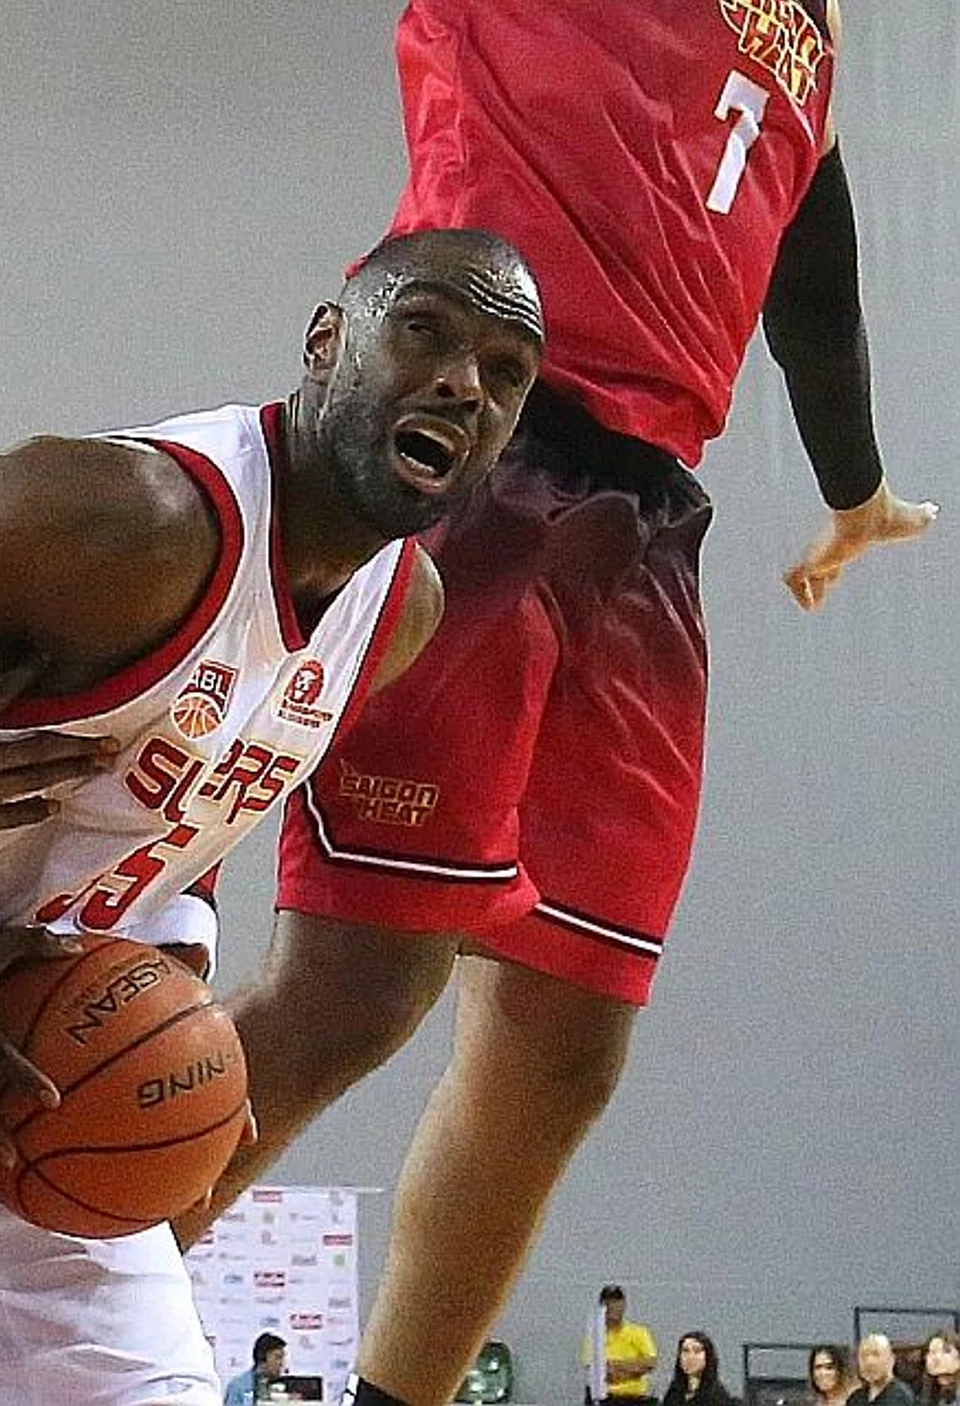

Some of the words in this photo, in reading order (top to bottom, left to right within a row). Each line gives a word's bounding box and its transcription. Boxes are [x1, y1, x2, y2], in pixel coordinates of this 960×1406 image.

[706, 70, 770, 214] 7
[191, 667, 228, 699] ABL
[340, 774, 438, 808] SAIGON
[358, 797, 434, 827] HEAT
